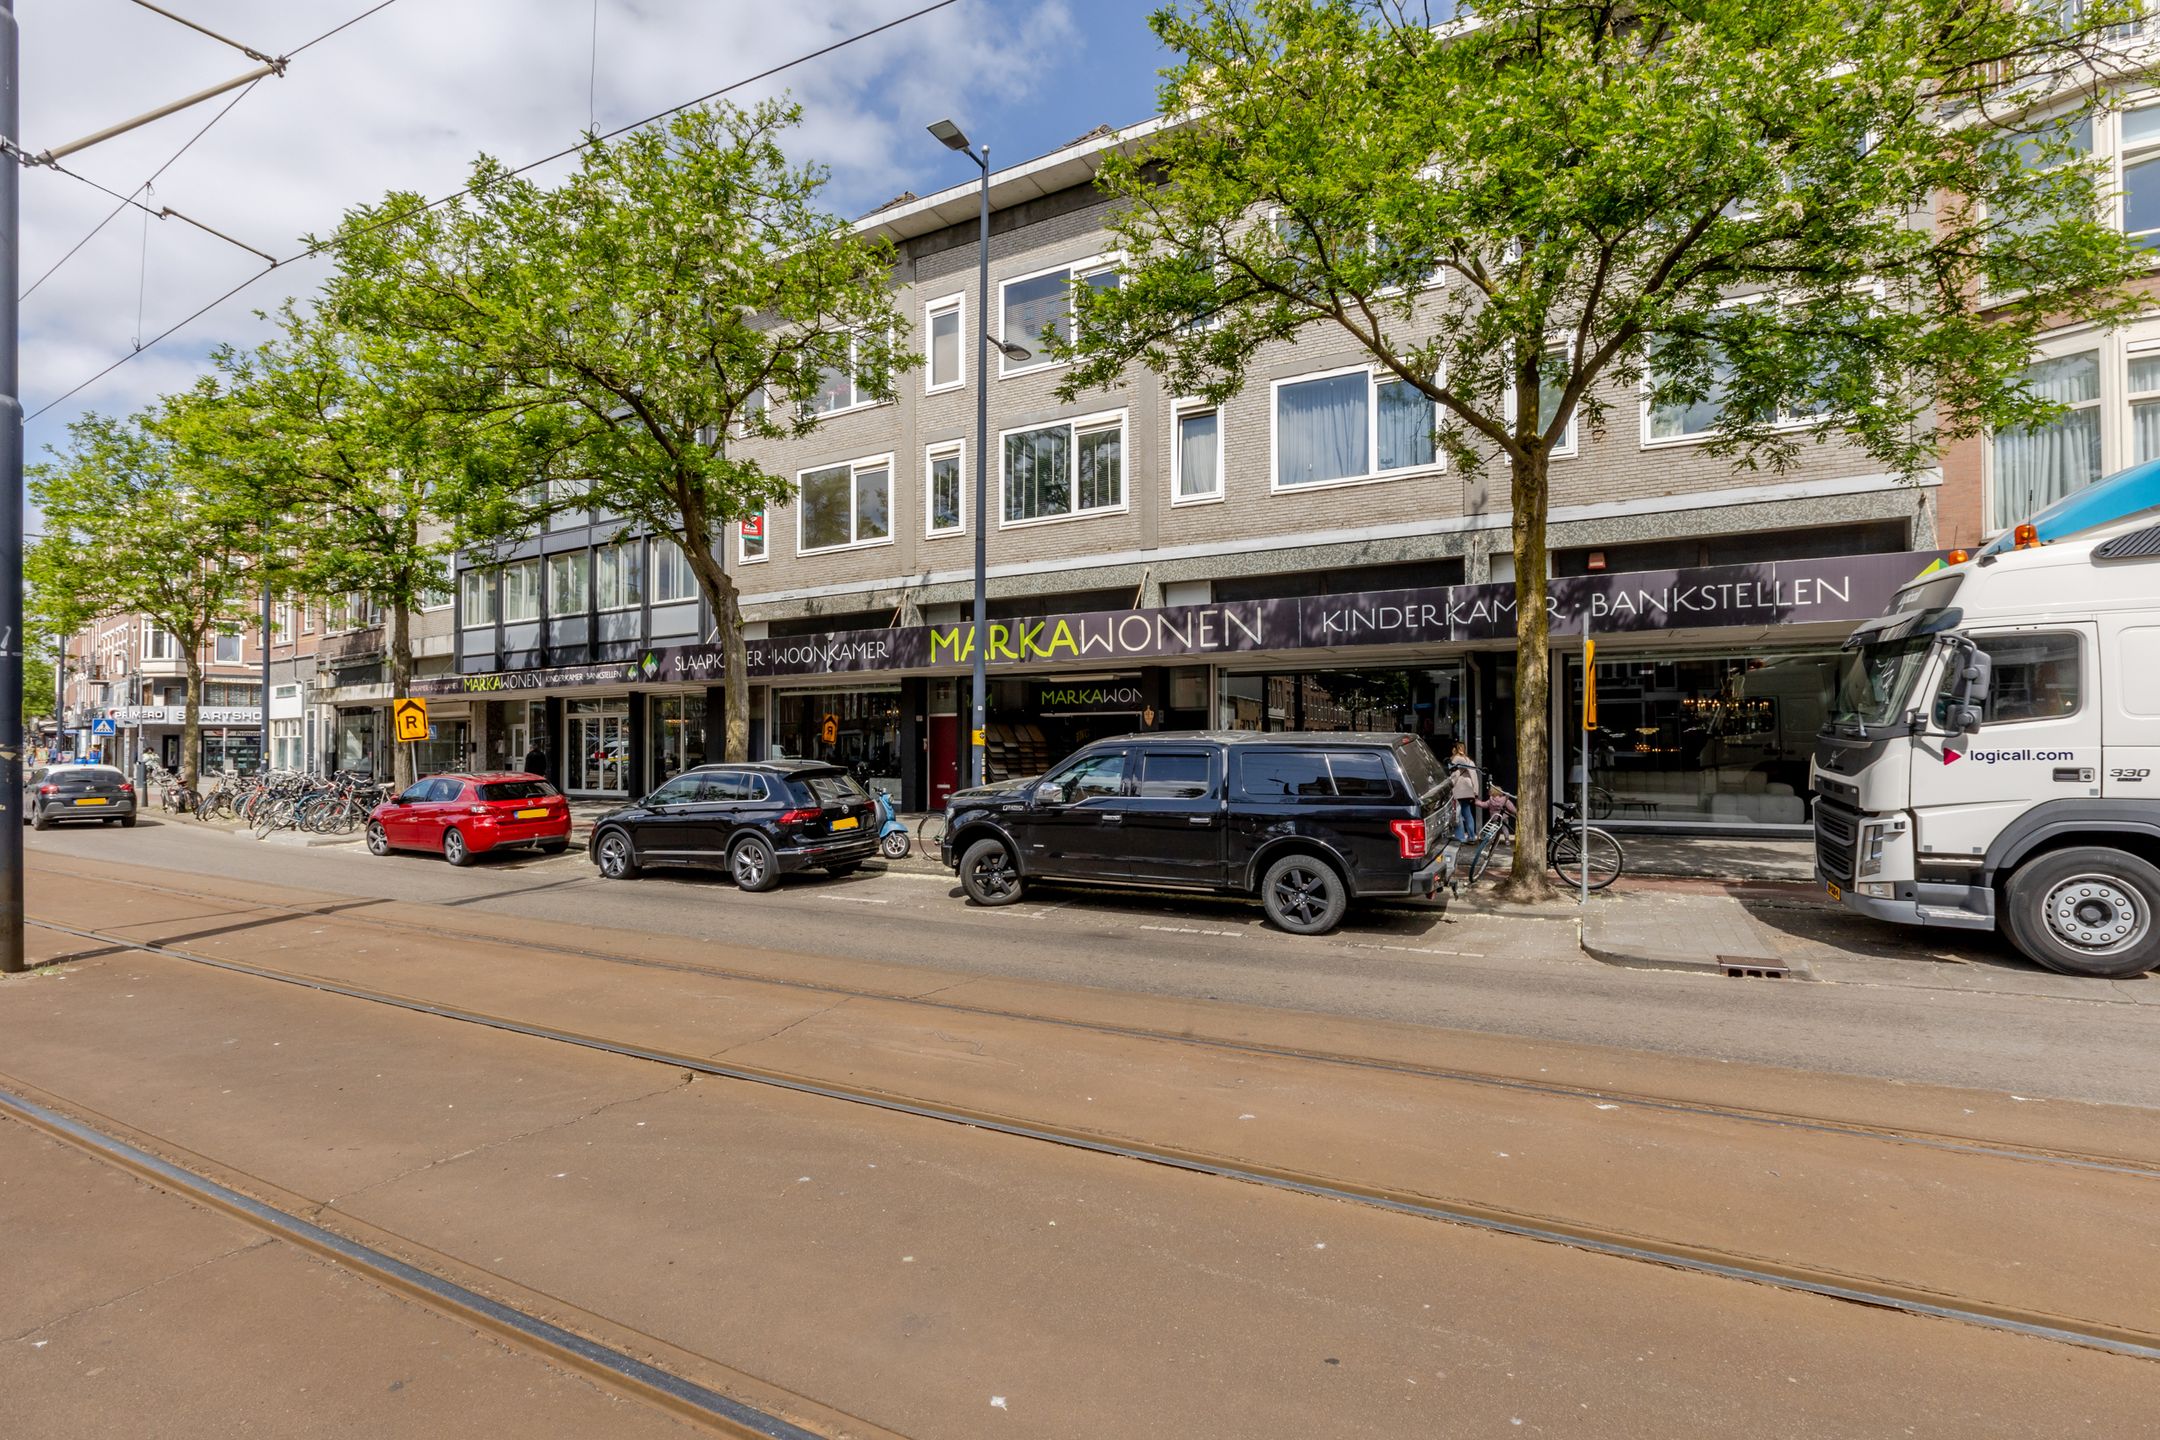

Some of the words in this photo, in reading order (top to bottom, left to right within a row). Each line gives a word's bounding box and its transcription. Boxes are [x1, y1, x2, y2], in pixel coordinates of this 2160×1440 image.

[1323, 596, 1567, 633] KINDERKAMR
[1592, 576, 1849, 617] BANKSTELLEN
[930, 606, 1262, 663] MARKAWONEN
[675, 650, 765, 672] SLAAPKER
[774, 641, 889, 665] WOONKAMER
[464, 672, 542, 692] MARKAWONEN
[115, 711, 164, 720] PRIMERO
[176, 711, 262, 721] SARTSHO
[405, 715, 417, 729] R
[1970, 750, 2074, 764] logicall.com
[2109, 768, 2151, 778] 330
